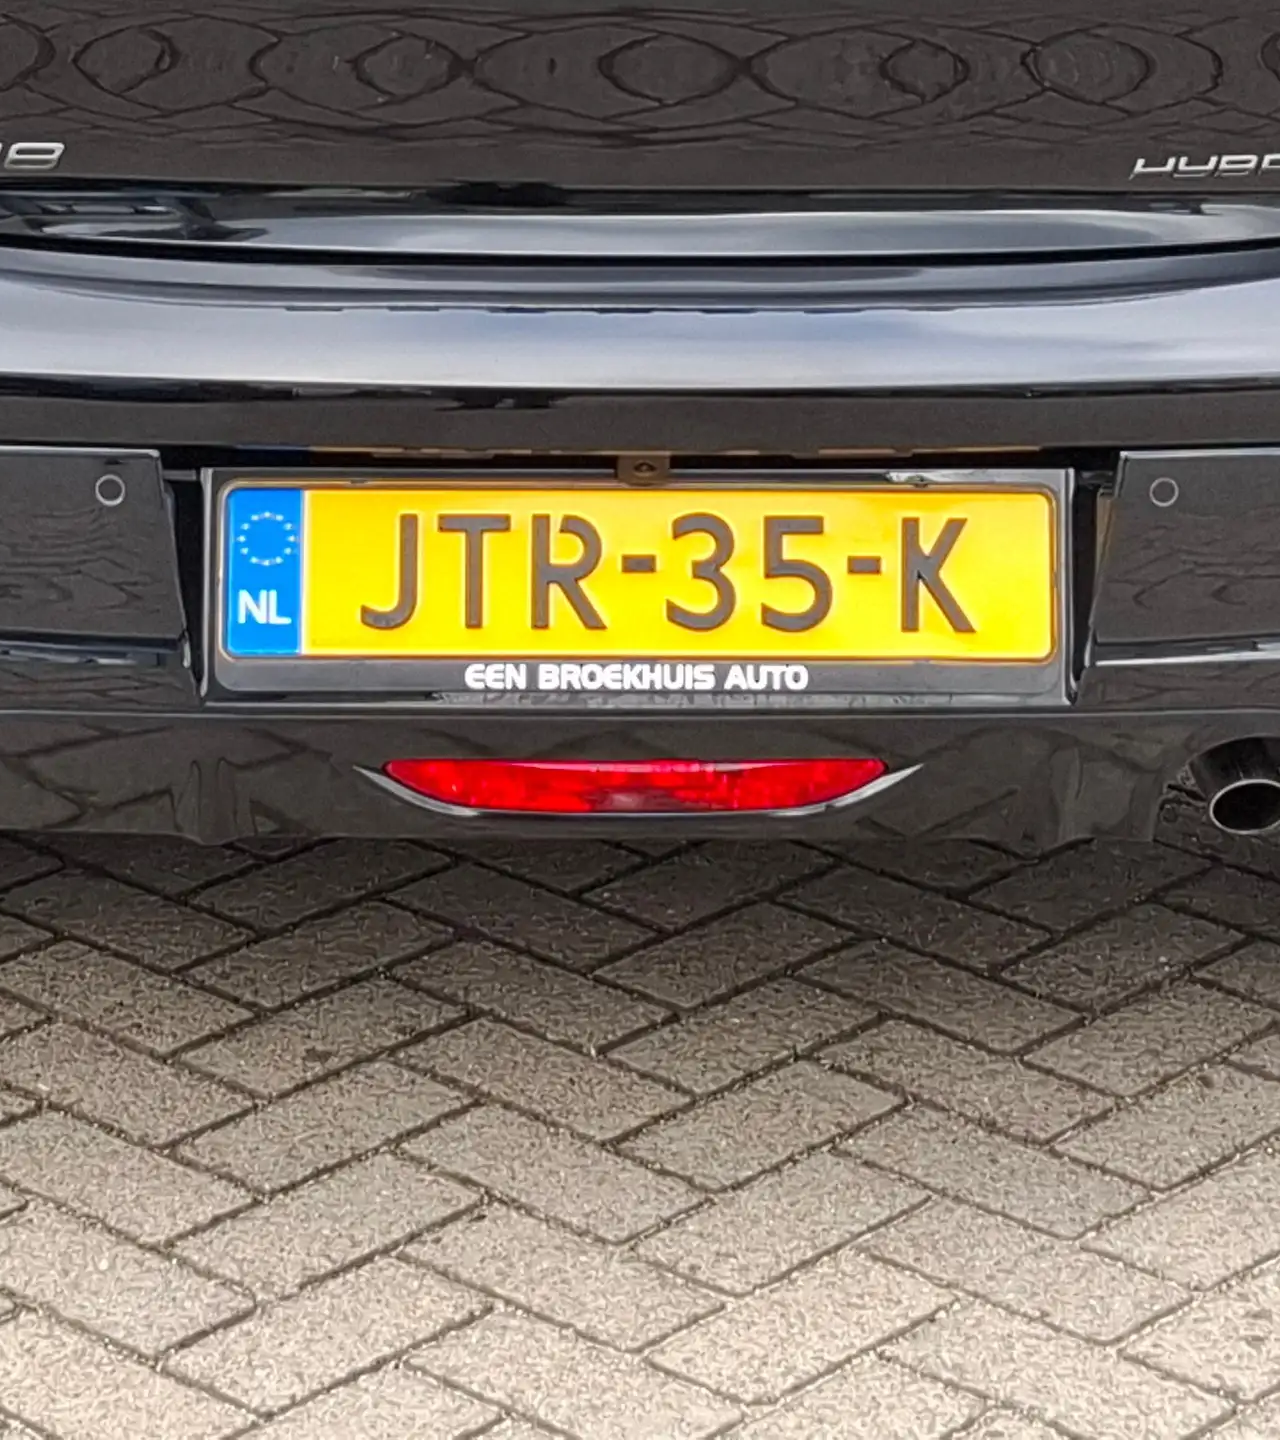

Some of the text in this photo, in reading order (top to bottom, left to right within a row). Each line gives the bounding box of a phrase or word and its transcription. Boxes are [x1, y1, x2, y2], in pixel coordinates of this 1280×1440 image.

[359, 513, 976, 635] JTR-35-K
[238, 589, 291, 626] NL
[464, 663, 809, 692] EEN BROEKHUIS AUTO
